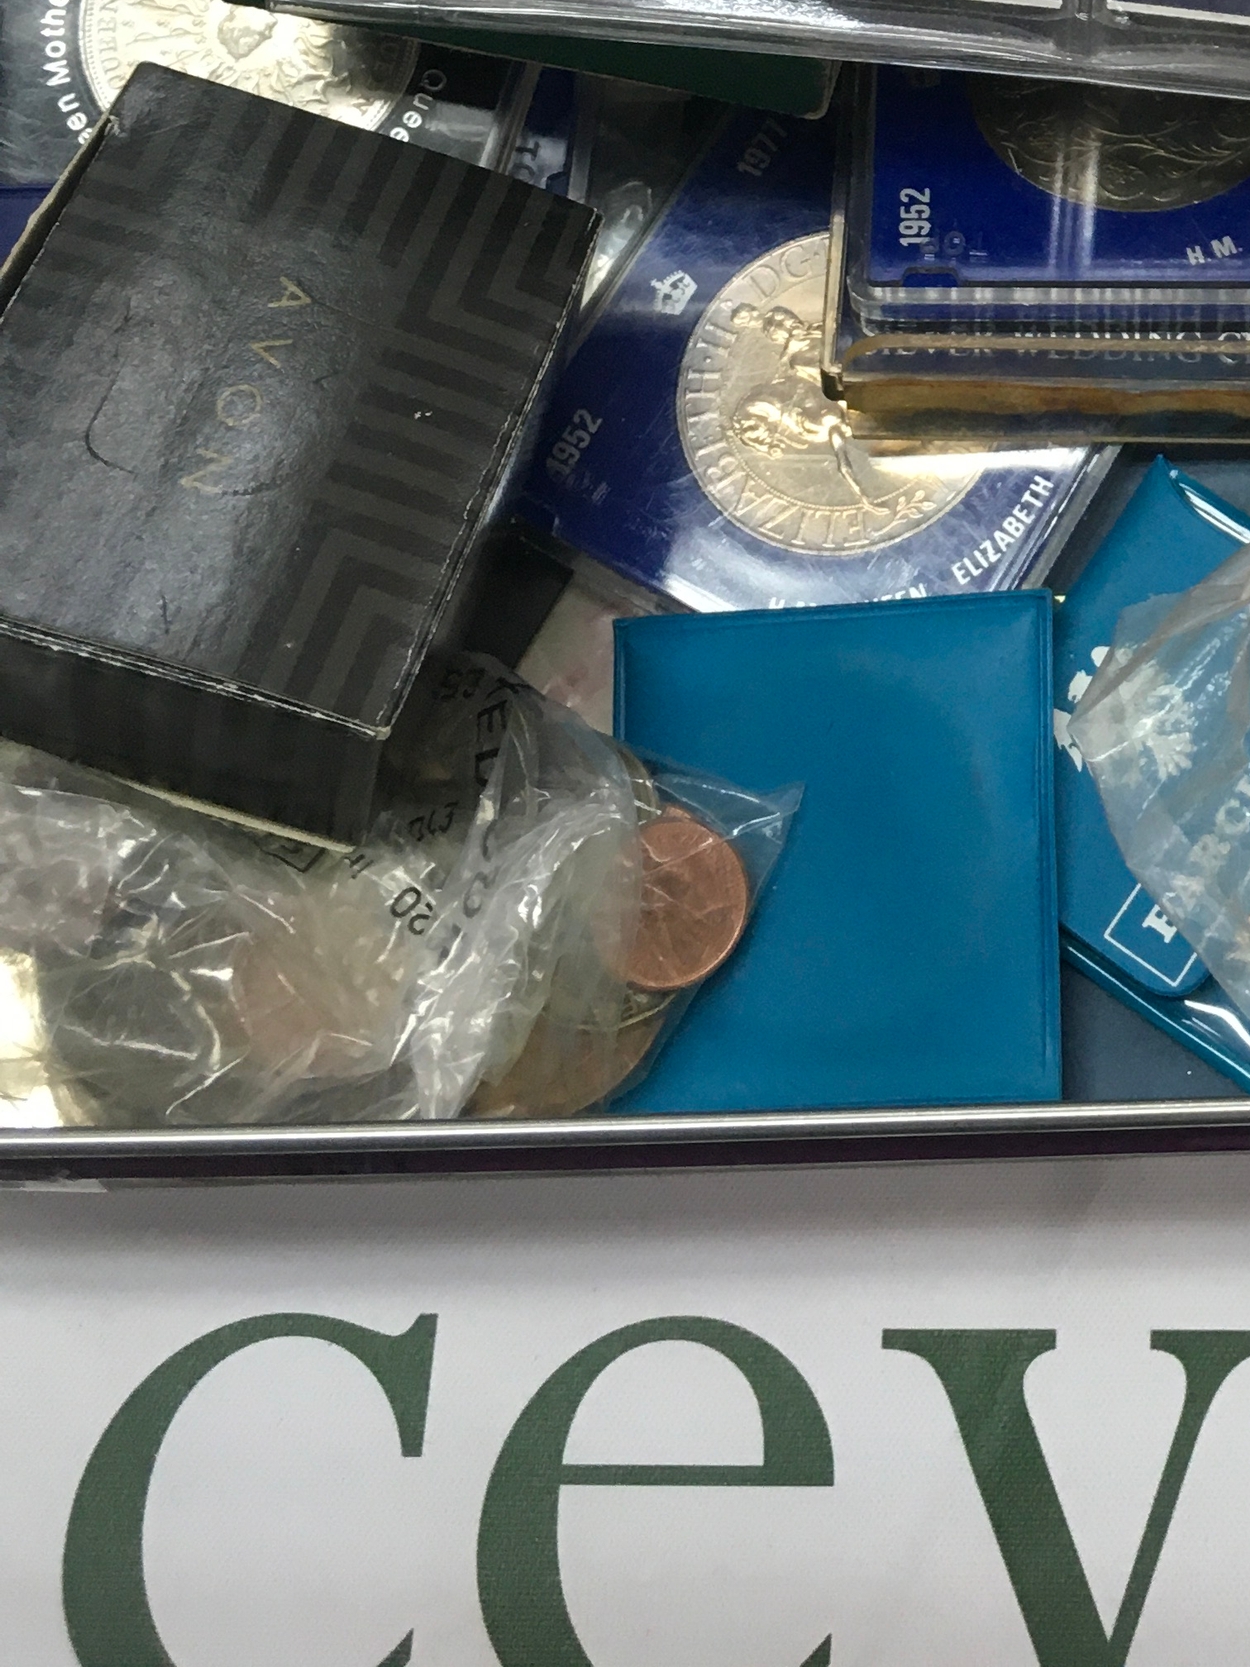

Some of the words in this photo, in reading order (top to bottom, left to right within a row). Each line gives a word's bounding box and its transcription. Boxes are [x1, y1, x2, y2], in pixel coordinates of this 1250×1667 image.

[388, 67, 447, 143] Quee
[898, 187, 932, 249] 1952
[179, 276, 312, 495] AVON
[545, 408, 604, 479] 1952
[950, 474, 1055, 585] ELIZABETH
[388, 885, 434, 935] 20
